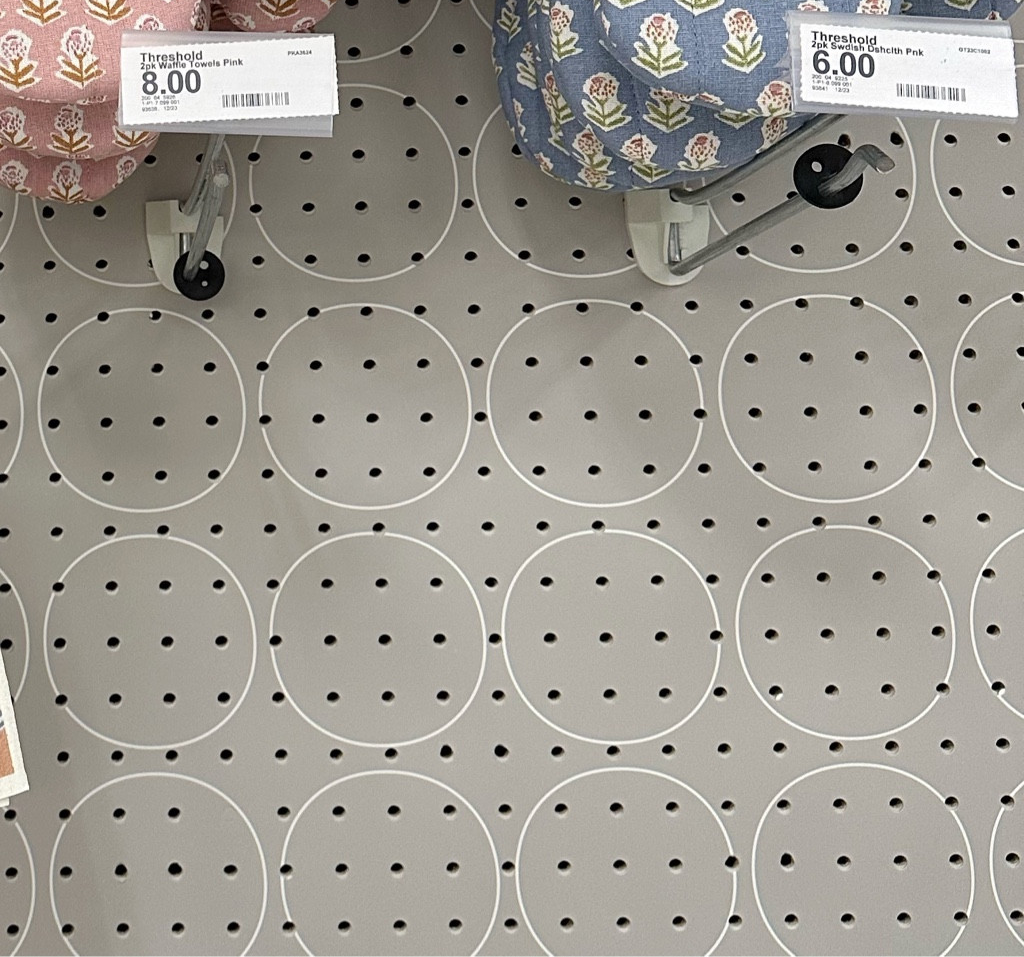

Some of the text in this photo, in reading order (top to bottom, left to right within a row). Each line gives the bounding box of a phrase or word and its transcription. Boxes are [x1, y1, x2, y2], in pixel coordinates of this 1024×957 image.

[811, 31, 877, 45] Threshold
[811, 40, 828, 50] 2pk
[831, 42, 865, 51] Swdish
[906, 48, 924, 56] Pnk
[140, 50, 203, 64] Threshold
[813, 50, 875, 78] 6.00
[140, 58, 243, 72] 2pk Waffle Towels Pink
[142, 69, 201, 95] 8.00
